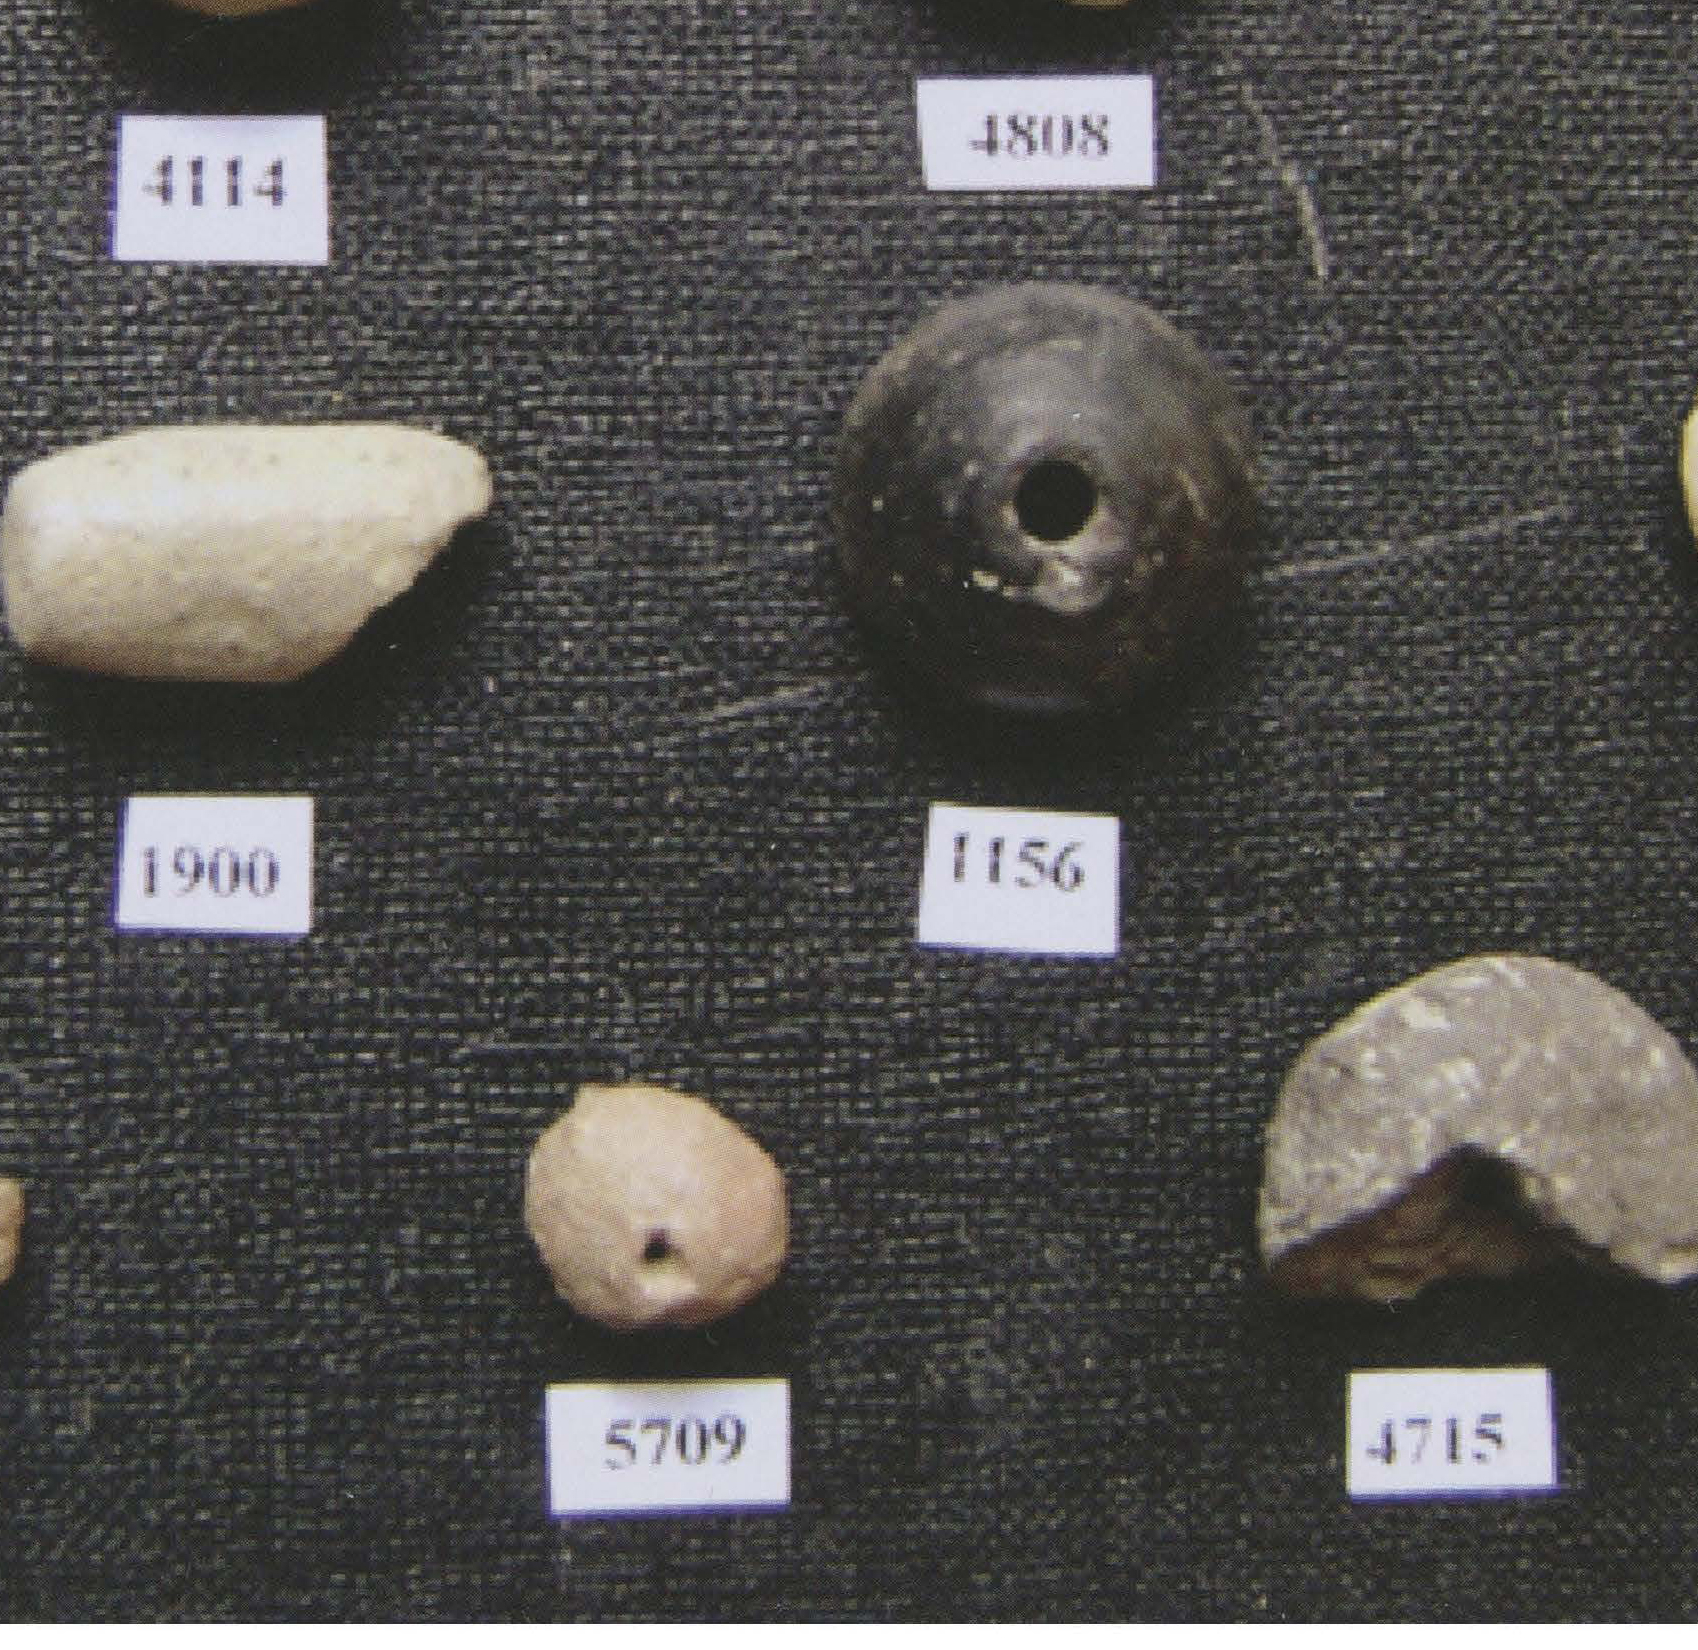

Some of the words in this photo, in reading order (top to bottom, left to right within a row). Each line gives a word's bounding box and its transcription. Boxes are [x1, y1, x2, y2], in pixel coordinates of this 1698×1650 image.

[969, 112, 1111, 160] 4808
[141, 155, 288, 210] 4114
[139, 844, 282, 899] 1900
[951, 832, 1086, 893] 1156
[603, 1413, 749, 1466] 5709
[1365, 1412, 1507, 1465] 4715
